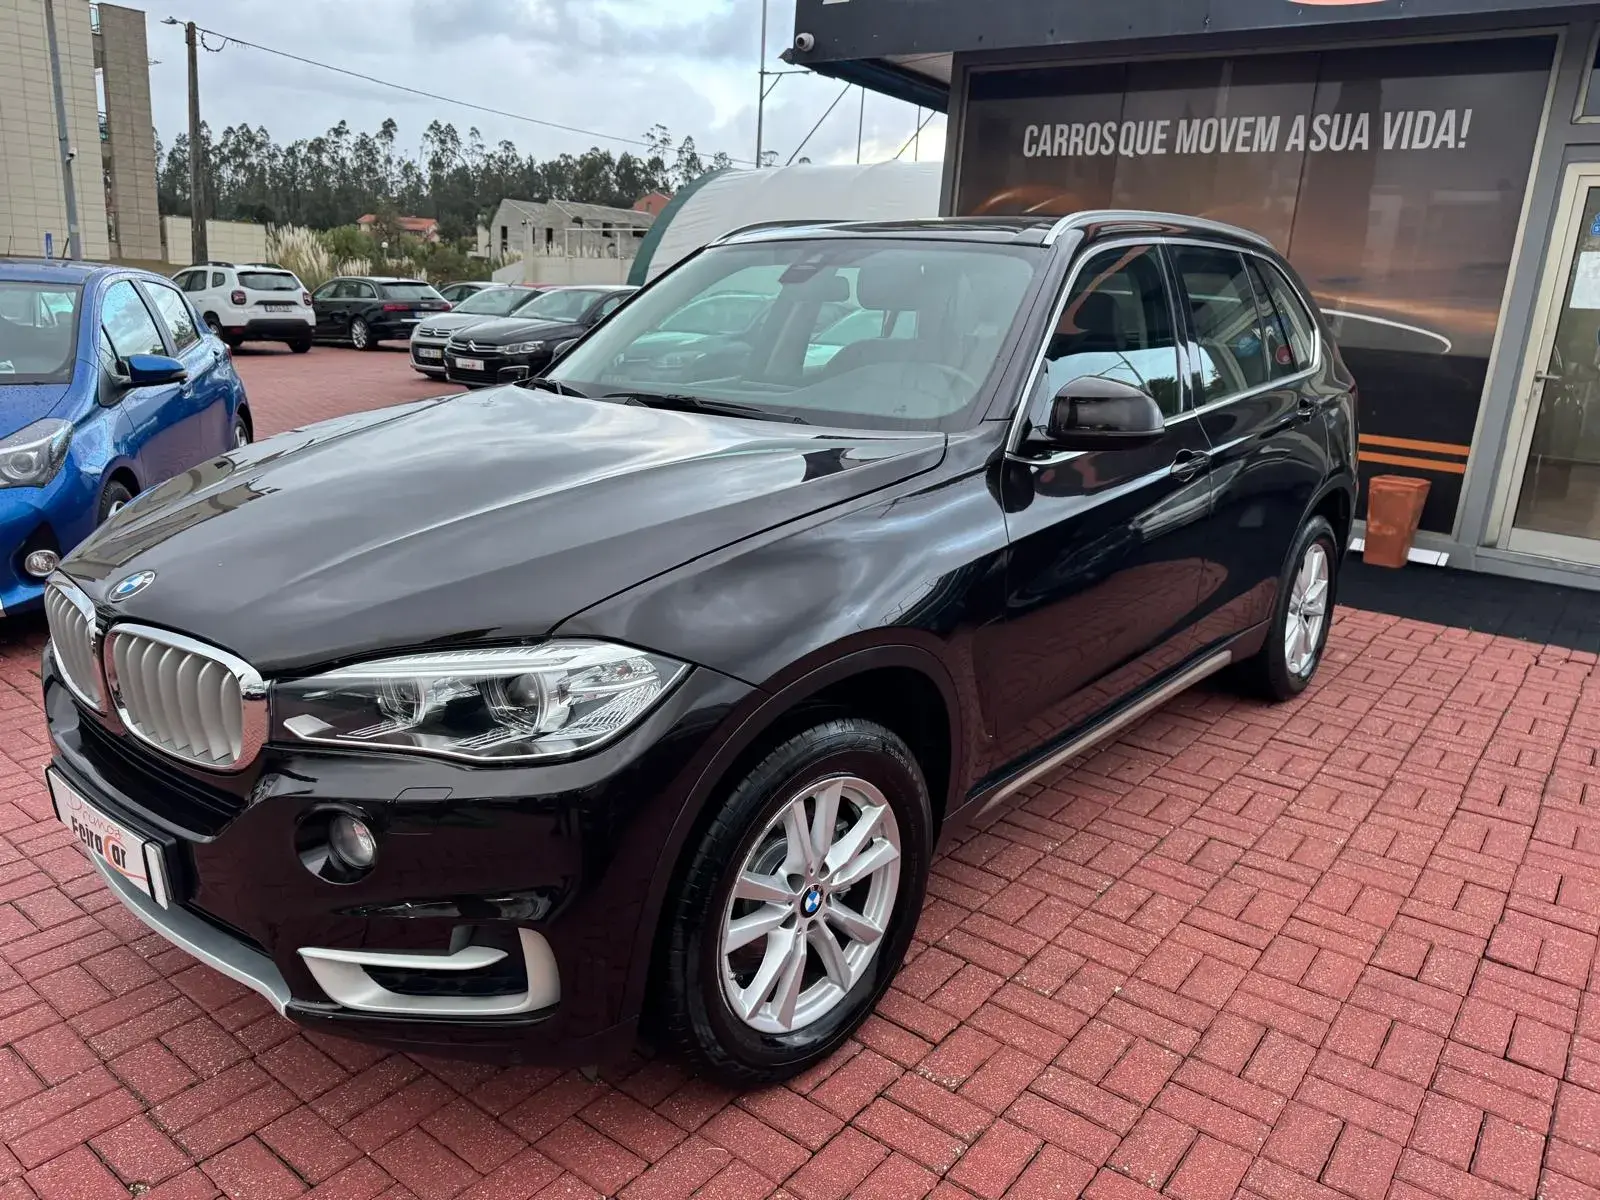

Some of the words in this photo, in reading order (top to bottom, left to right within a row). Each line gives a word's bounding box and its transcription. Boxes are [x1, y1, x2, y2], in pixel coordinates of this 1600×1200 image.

[1023, 122, 1117, 157] CARROS
[1118, 120, 1170, 157] QUE
[1175, 116, 1280, 154] MOVEM
[1383, 108, 1473, 150] VIDA!
